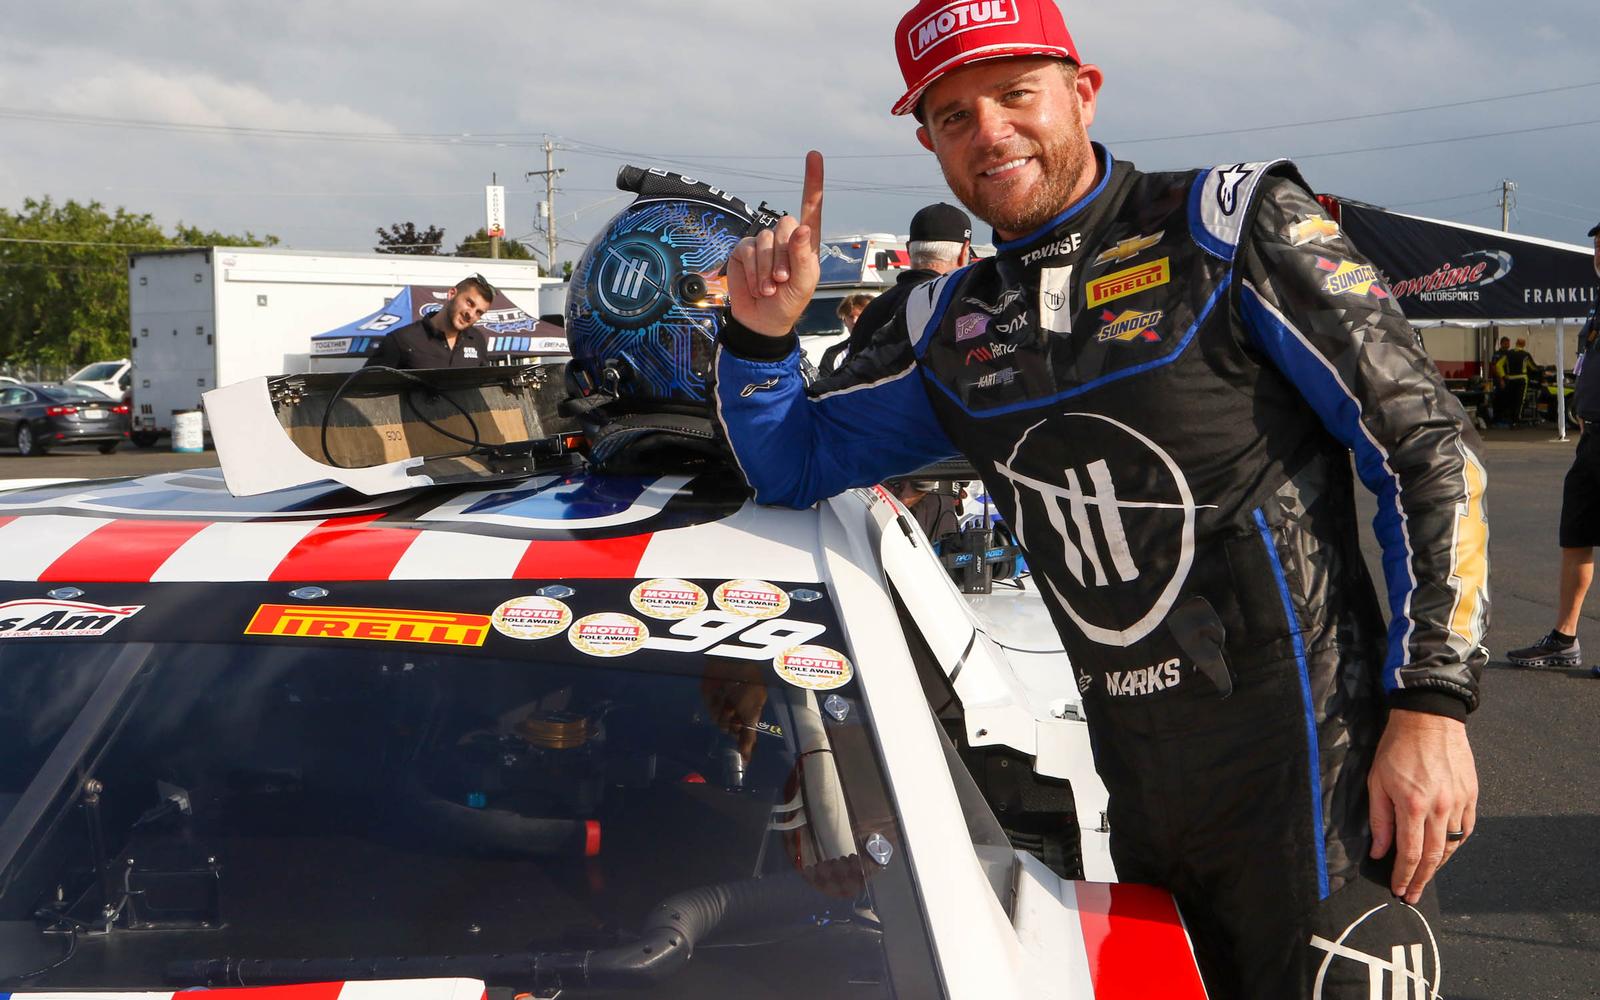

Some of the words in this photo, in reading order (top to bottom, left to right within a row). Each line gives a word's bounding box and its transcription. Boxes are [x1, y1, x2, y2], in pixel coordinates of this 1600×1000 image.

[918, 1, 1007, 50] MOTUL
[492, 223, 501, 233] 3
[1092, 265, 1162, 301] PIRELLI
[1330, 265, 1375, 293] SUNOCO
[1420, 291, 1480, 302] MOTORSPORTS
[1524, 287, 1599, 303] FRANKLI
[358, 312, 401, 331] 12
[1100, 311, 1162, 340] SUNOCO
[644, 590, 697, 600] MOTUL
[726, 590, 779, 601] MOTUL
[17, 611, 117, 631] Am
[506, 608, 561, 618] MOTUL
[247, 605, 490, 645] PIRELLI
[583, 626, 637, 635] MOTUL
[643, 610, 827, 660] 99
[787, 656, 841, 668] MOTUL
[809, 667, 843, 675] AWARD
[1105, 658, 1181, 696] MARKS
